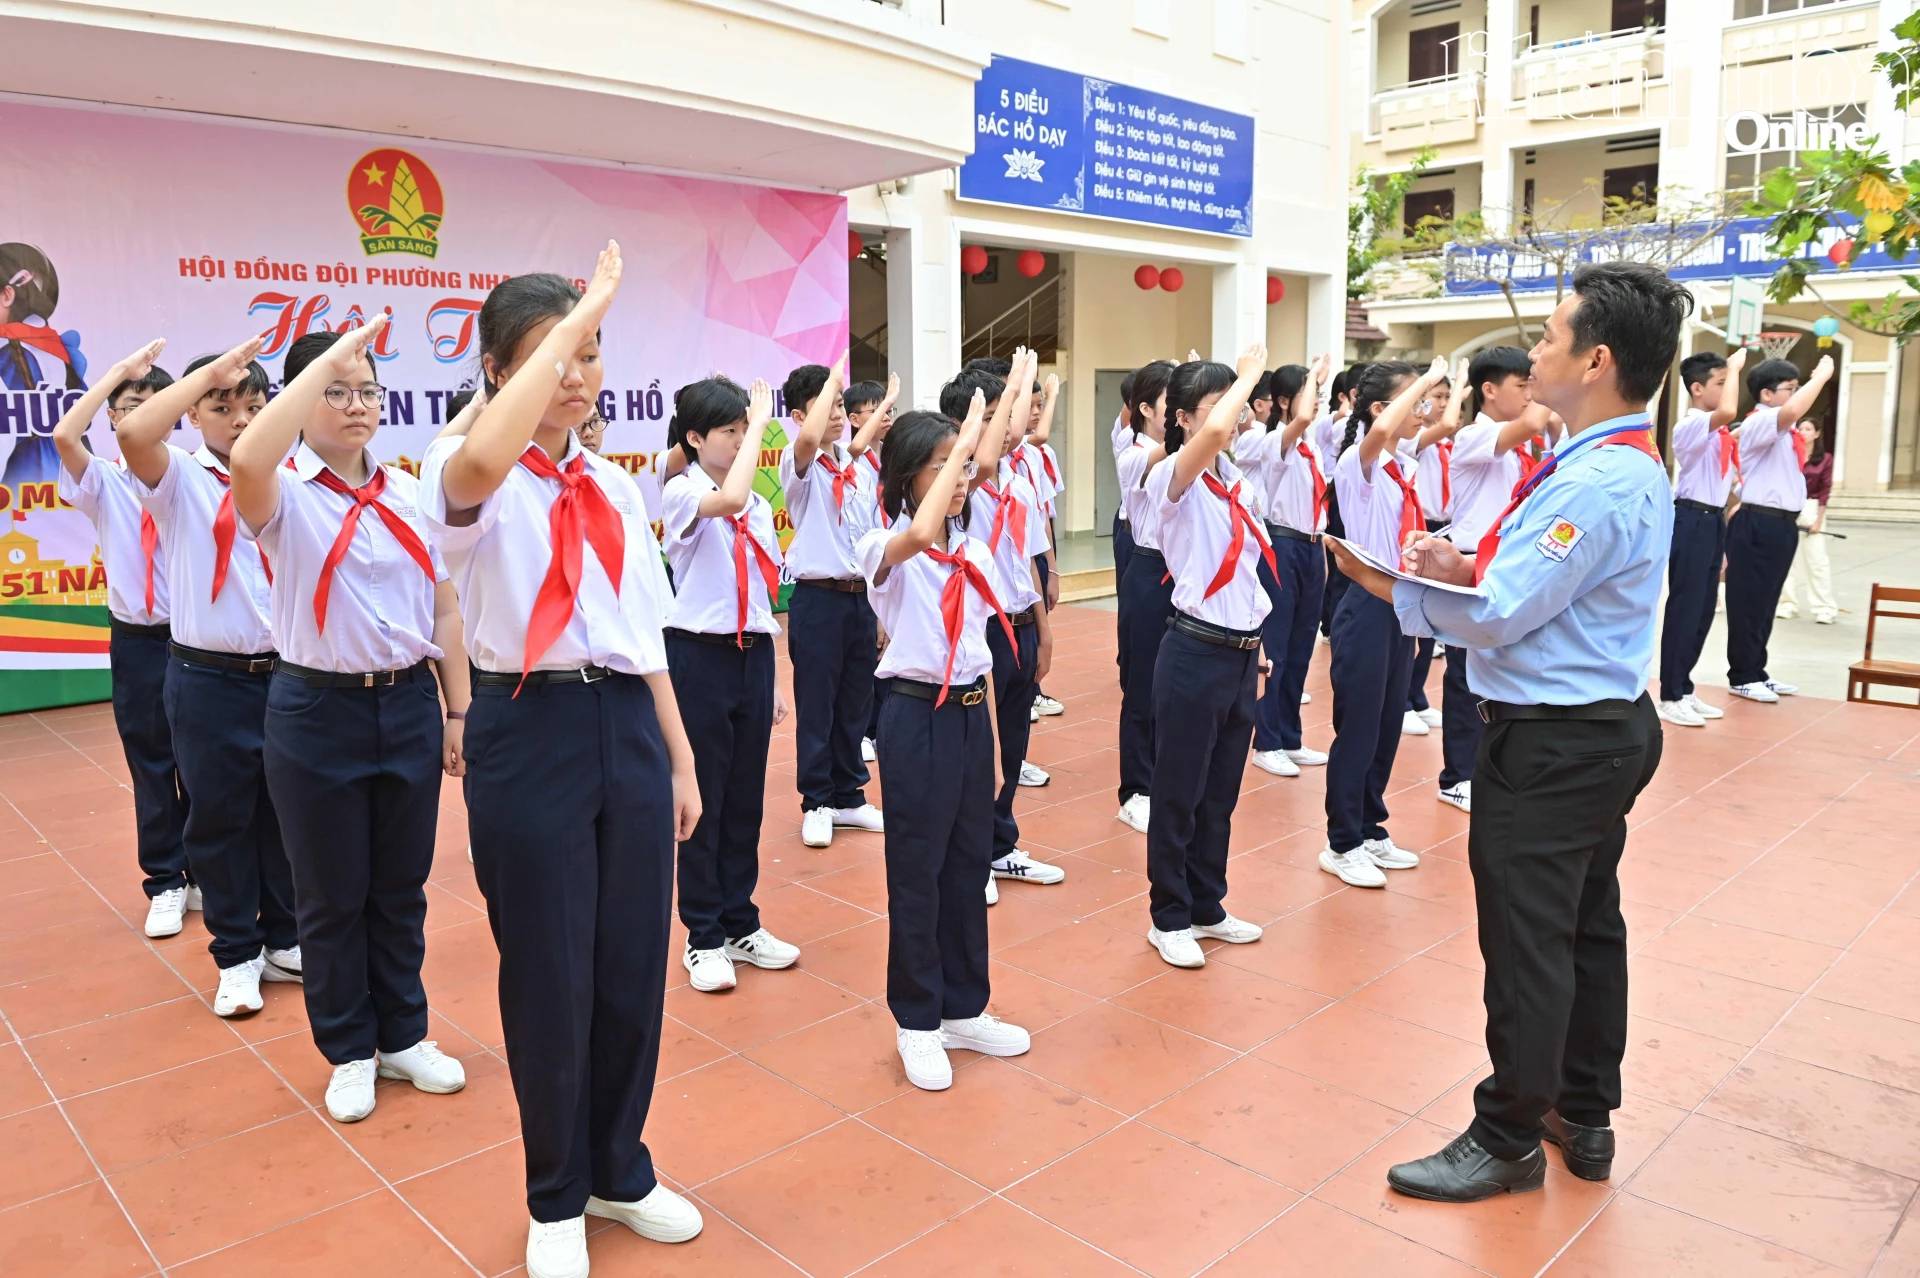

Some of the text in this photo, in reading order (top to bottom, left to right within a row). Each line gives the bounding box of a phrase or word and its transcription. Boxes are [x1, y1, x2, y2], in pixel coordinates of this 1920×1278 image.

[1000, 88, 1048, 116] 5 ĐIỀU
[1095, 96, 1115, 113] Điều
[1118, 101, 1125, 115] 1:
[1128, 104, 1145, 120] Yêu
[1147, 106, 1156, 122] tổ
[1158, 112, 1180, 129] quốc,
[1182, 118, 1198, 132] yêu
[1199, 120, 1219, 139] đồng
[978, 111, 1067, 148] BÁC HỒ DẠY
[1095, 118, 1114, 135] Điều
[1116, 123, 1125, 136] 2:
[1127, 125, 1144, 142] Học
[1147, 130, 1161, 146] tập
[1177, 136, 1190, 150] lao
[1192, 140, 1212, 158] động
[1095, 140, 1114, 156] Điều
[1116, 145, 1124, 158] 3:
[1127, 146, 1150, 163] Đoàn
[1152, 152, 1165, 165] kết
[1181, 156, 1191, 172] kỷ
[1193, 160, 1207, 175] luật
[1095, 161, 1114, 178] Điều
[1116, 167, 1124, 179] 4:
[1126, 168, 1142, 182] Giữ
[1144, 172, 1157, 186] gìn
[1159, 174, 1169, 189] vệ
[1171, 177, 1186, 190] sinh
[1094, 183, 1114, 199] Điều
[1116, 187, 1124, 200] 5:
[1126, 189, 1152, 204] Khiêm
[1154, 193, 1169, 209] tốn,
[1171, 196, 1186, 212] thật
[1204, 202, 1224, 219] dũng
[1225, 204, 1243, 220] cảm.
[368, 236, 434, 255] SẴN SÀNG
[179, 255, 225, 282] HỘI
[234, 256, 308, 282] ĐỒNG
[316, 262, 357, 287] ĐỘI
[366, 265, 462, 289] PHƯỜNG
[0, 383, 92, 435] HỨ
[626, 378, 664, 421] HỒ
[1, 559, 108, 597] 51 NĂ
